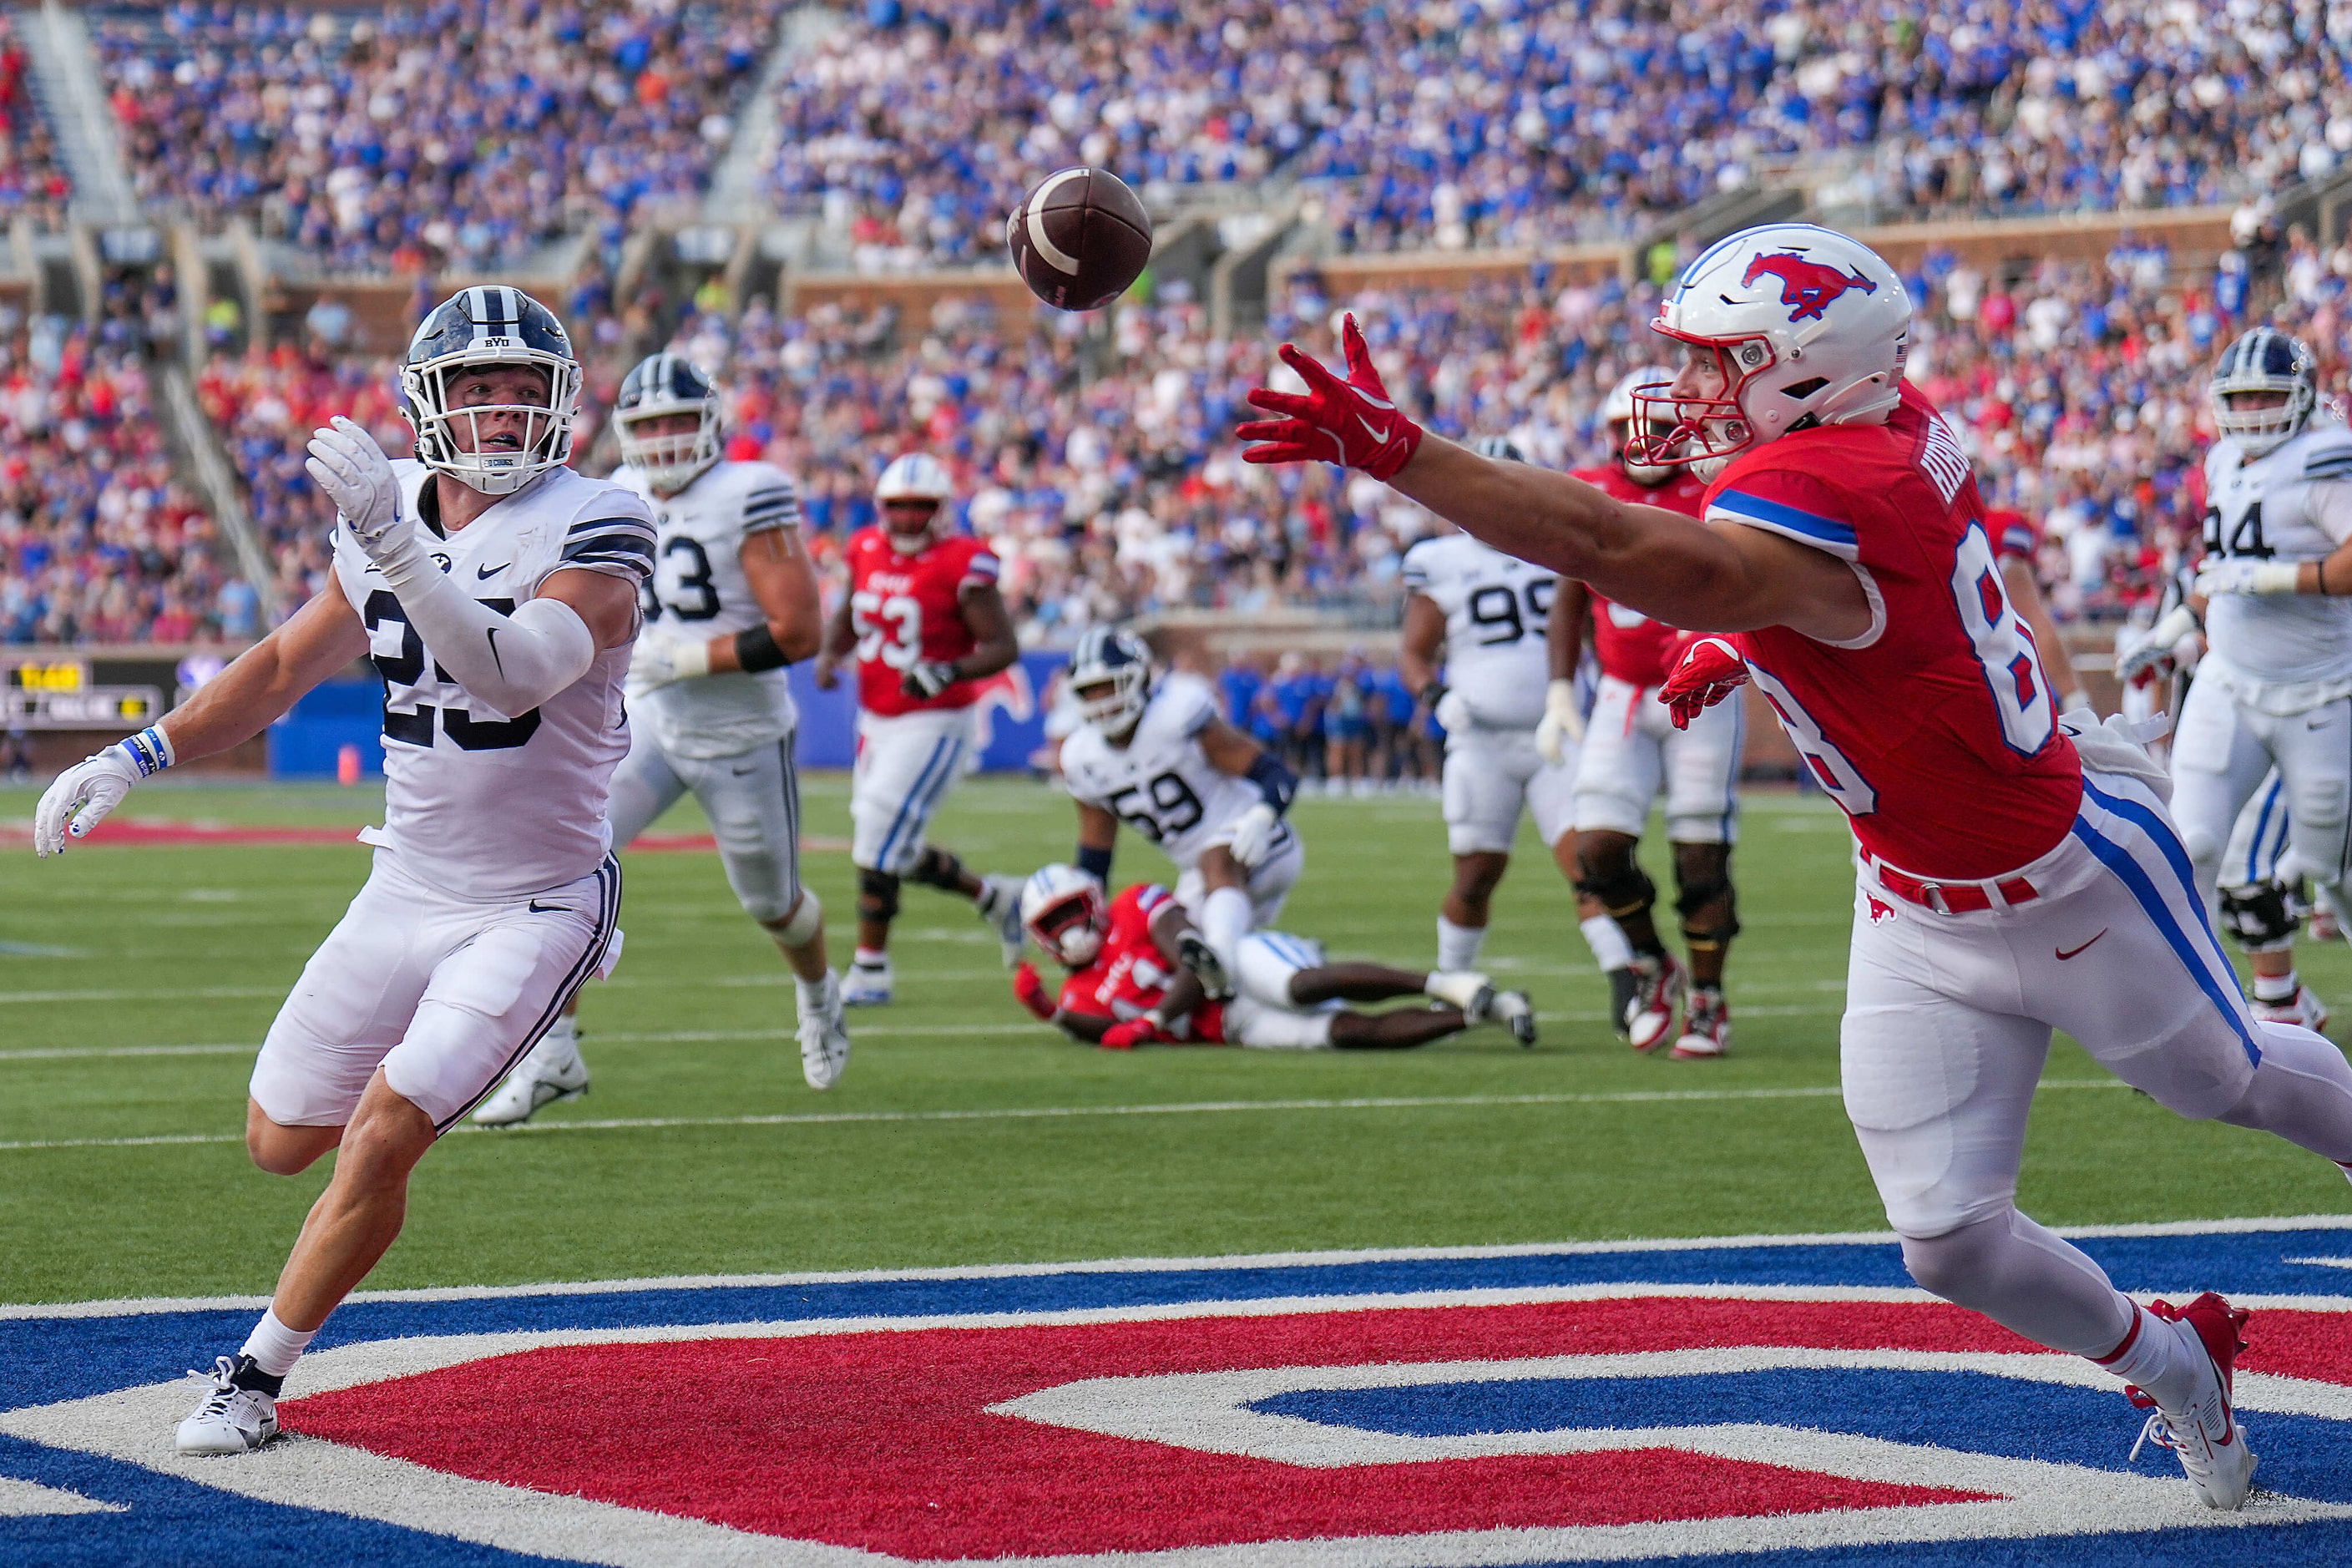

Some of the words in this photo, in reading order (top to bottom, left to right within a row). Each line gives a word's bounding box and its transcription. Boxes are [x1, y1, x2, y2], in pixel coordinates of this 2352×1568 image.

[484, 337, 509, 347] BYU
[851, 591, 921, 667] 53
[1109, 771, 1203, 843] 59
